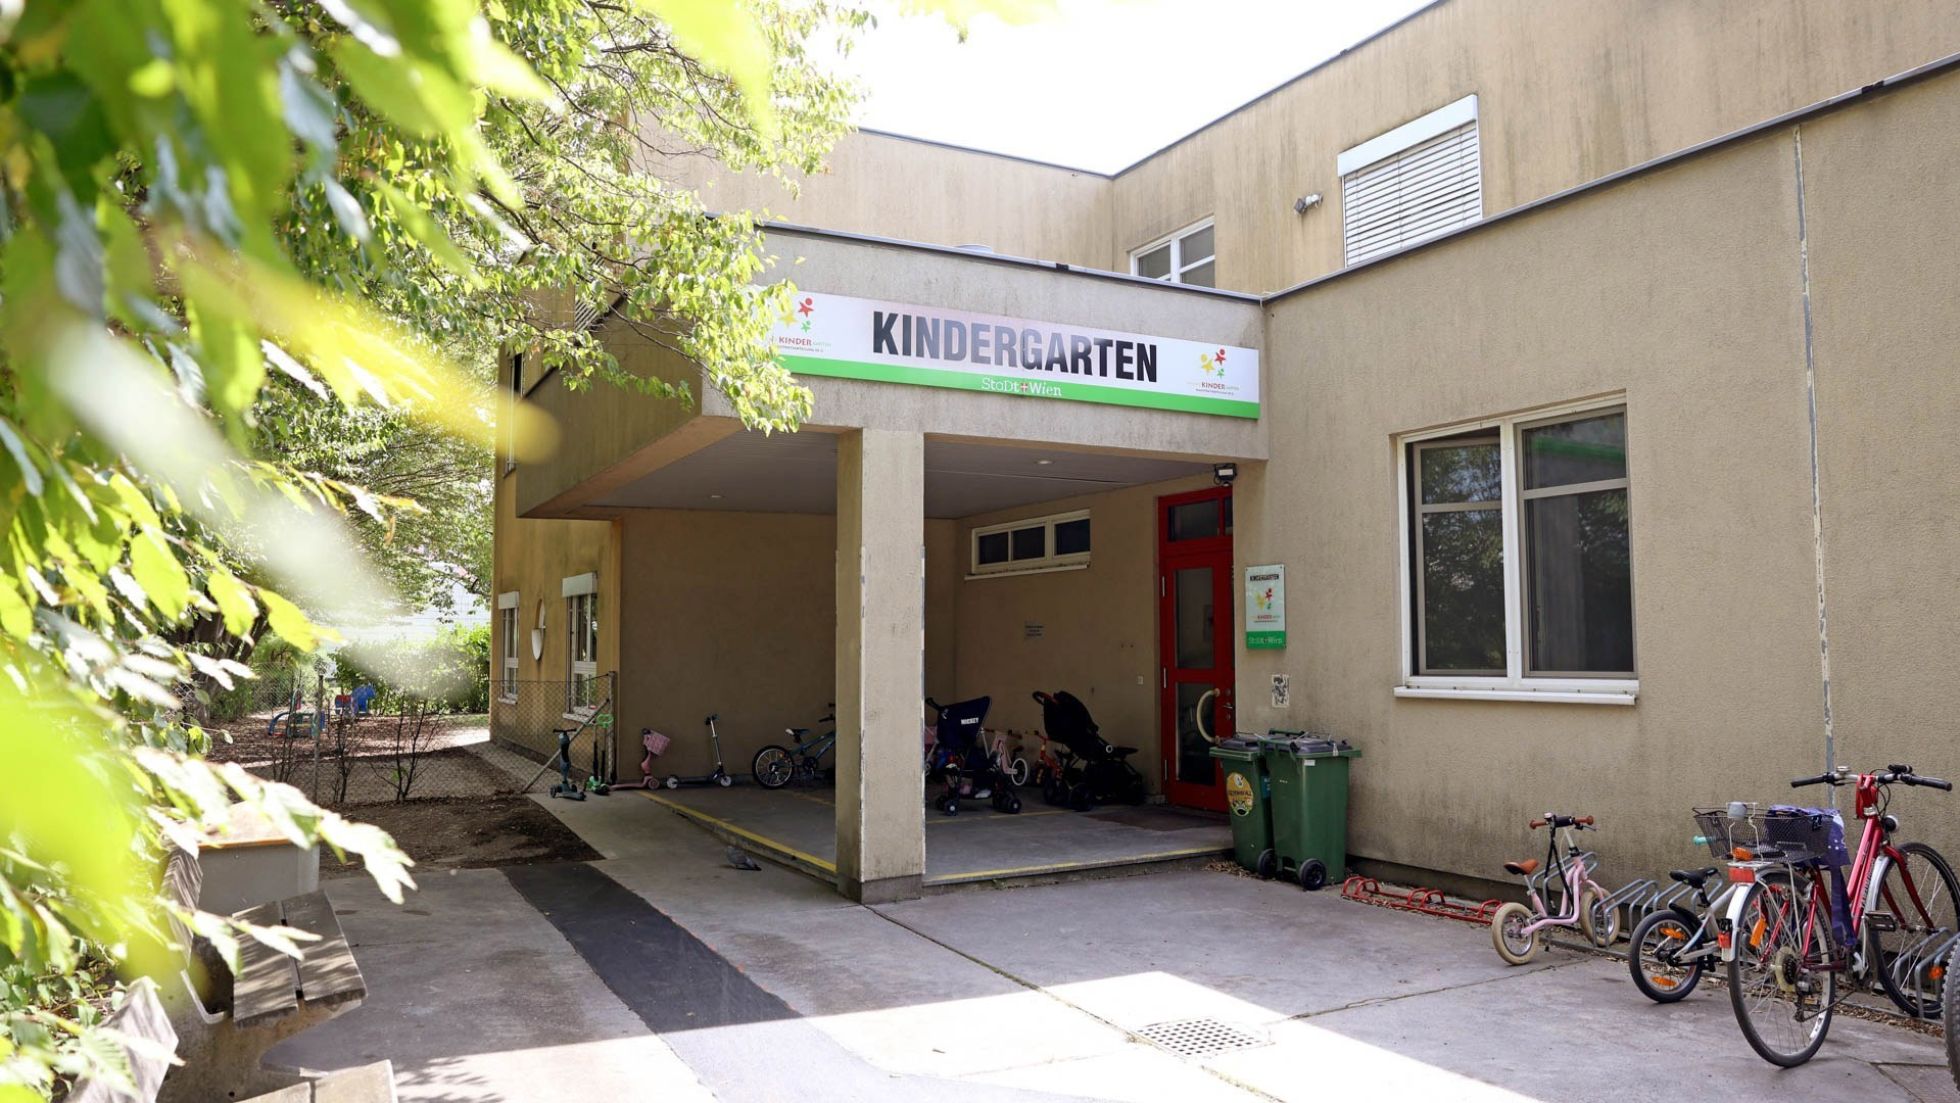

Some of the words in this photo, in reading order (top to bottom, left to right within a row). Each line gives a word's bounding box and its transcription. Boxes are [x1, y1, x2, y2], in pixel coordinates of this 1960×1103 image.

[778, 336, 812, 346] KINDER
[873, 311, 1157, 383] KINDERGARTEN
[1029, 382, 1062, 396] Wien
[1201, 381, 1225, 390] KINDER
